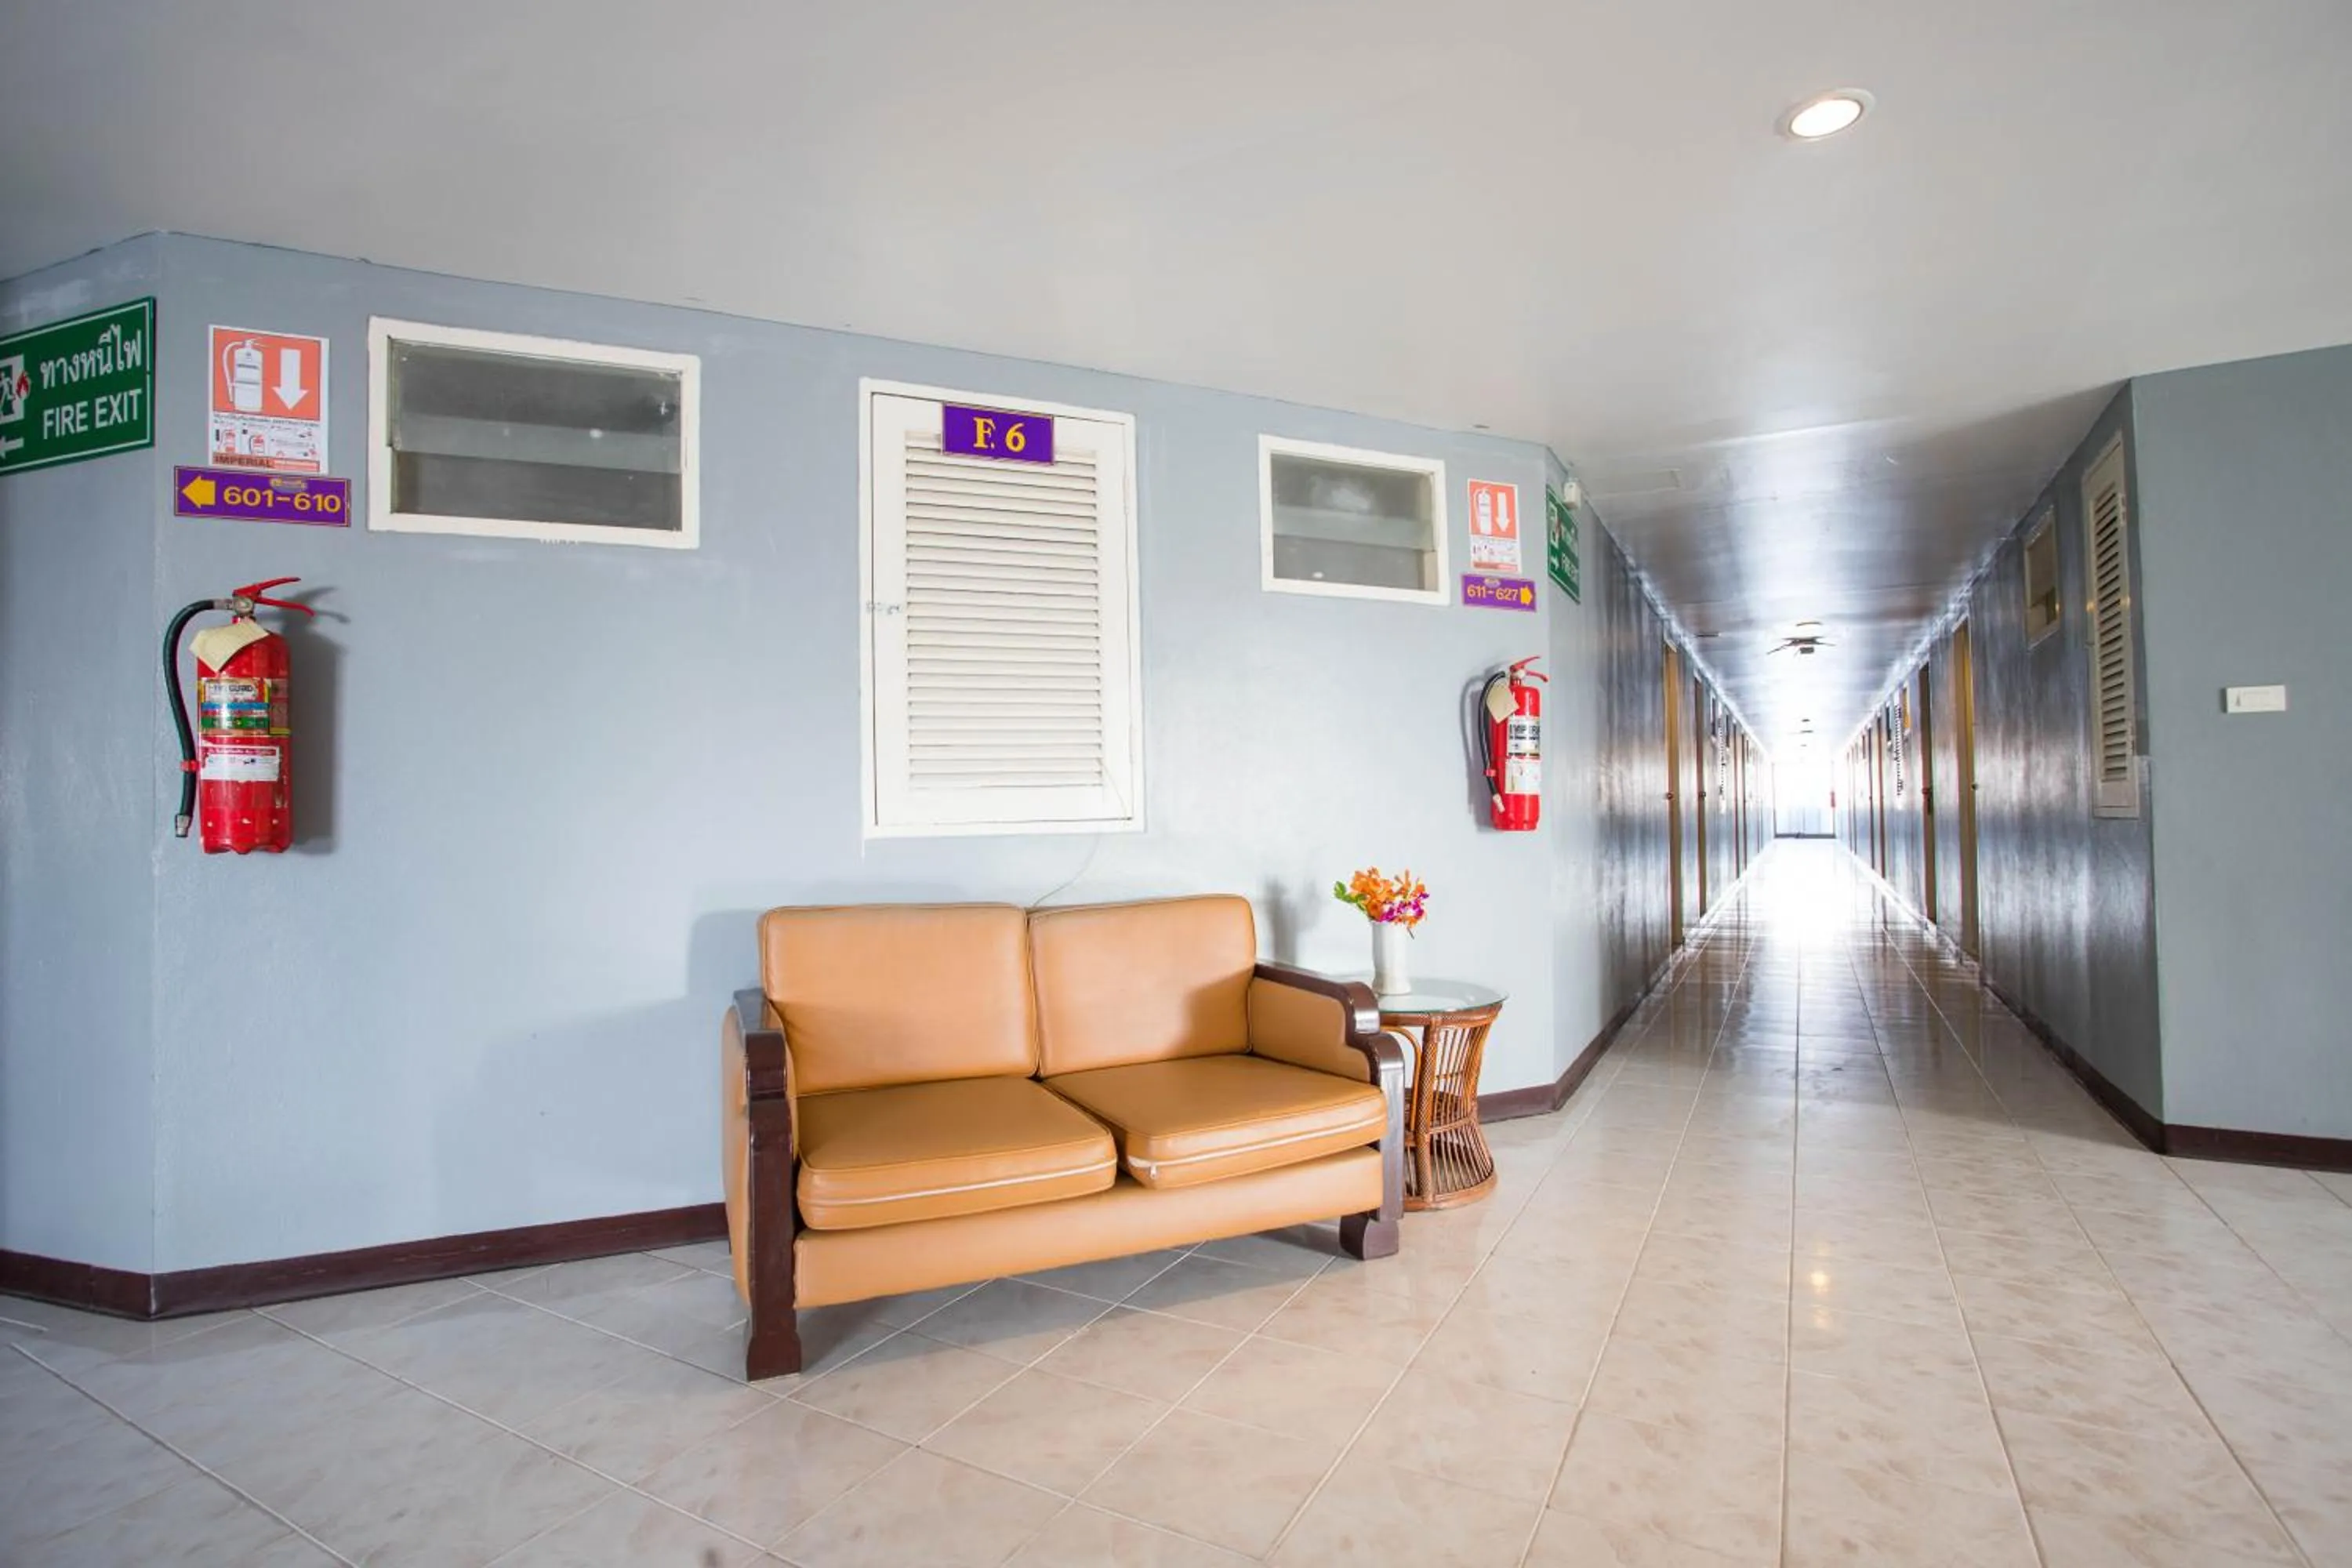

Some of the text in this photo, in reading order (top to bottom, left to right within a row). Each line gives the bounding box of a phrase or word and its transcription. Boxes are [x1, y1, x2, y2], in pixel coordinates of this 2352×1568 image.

[41, 324, 142, 389] ทางหนีไฟ
[43, 388, 142, 440] FIRE EXIT
[1005, 423, 1026, 452] 6
[223, 487, 341, 513] 601-610
[1467, 584, 1519, 601] 611-627
